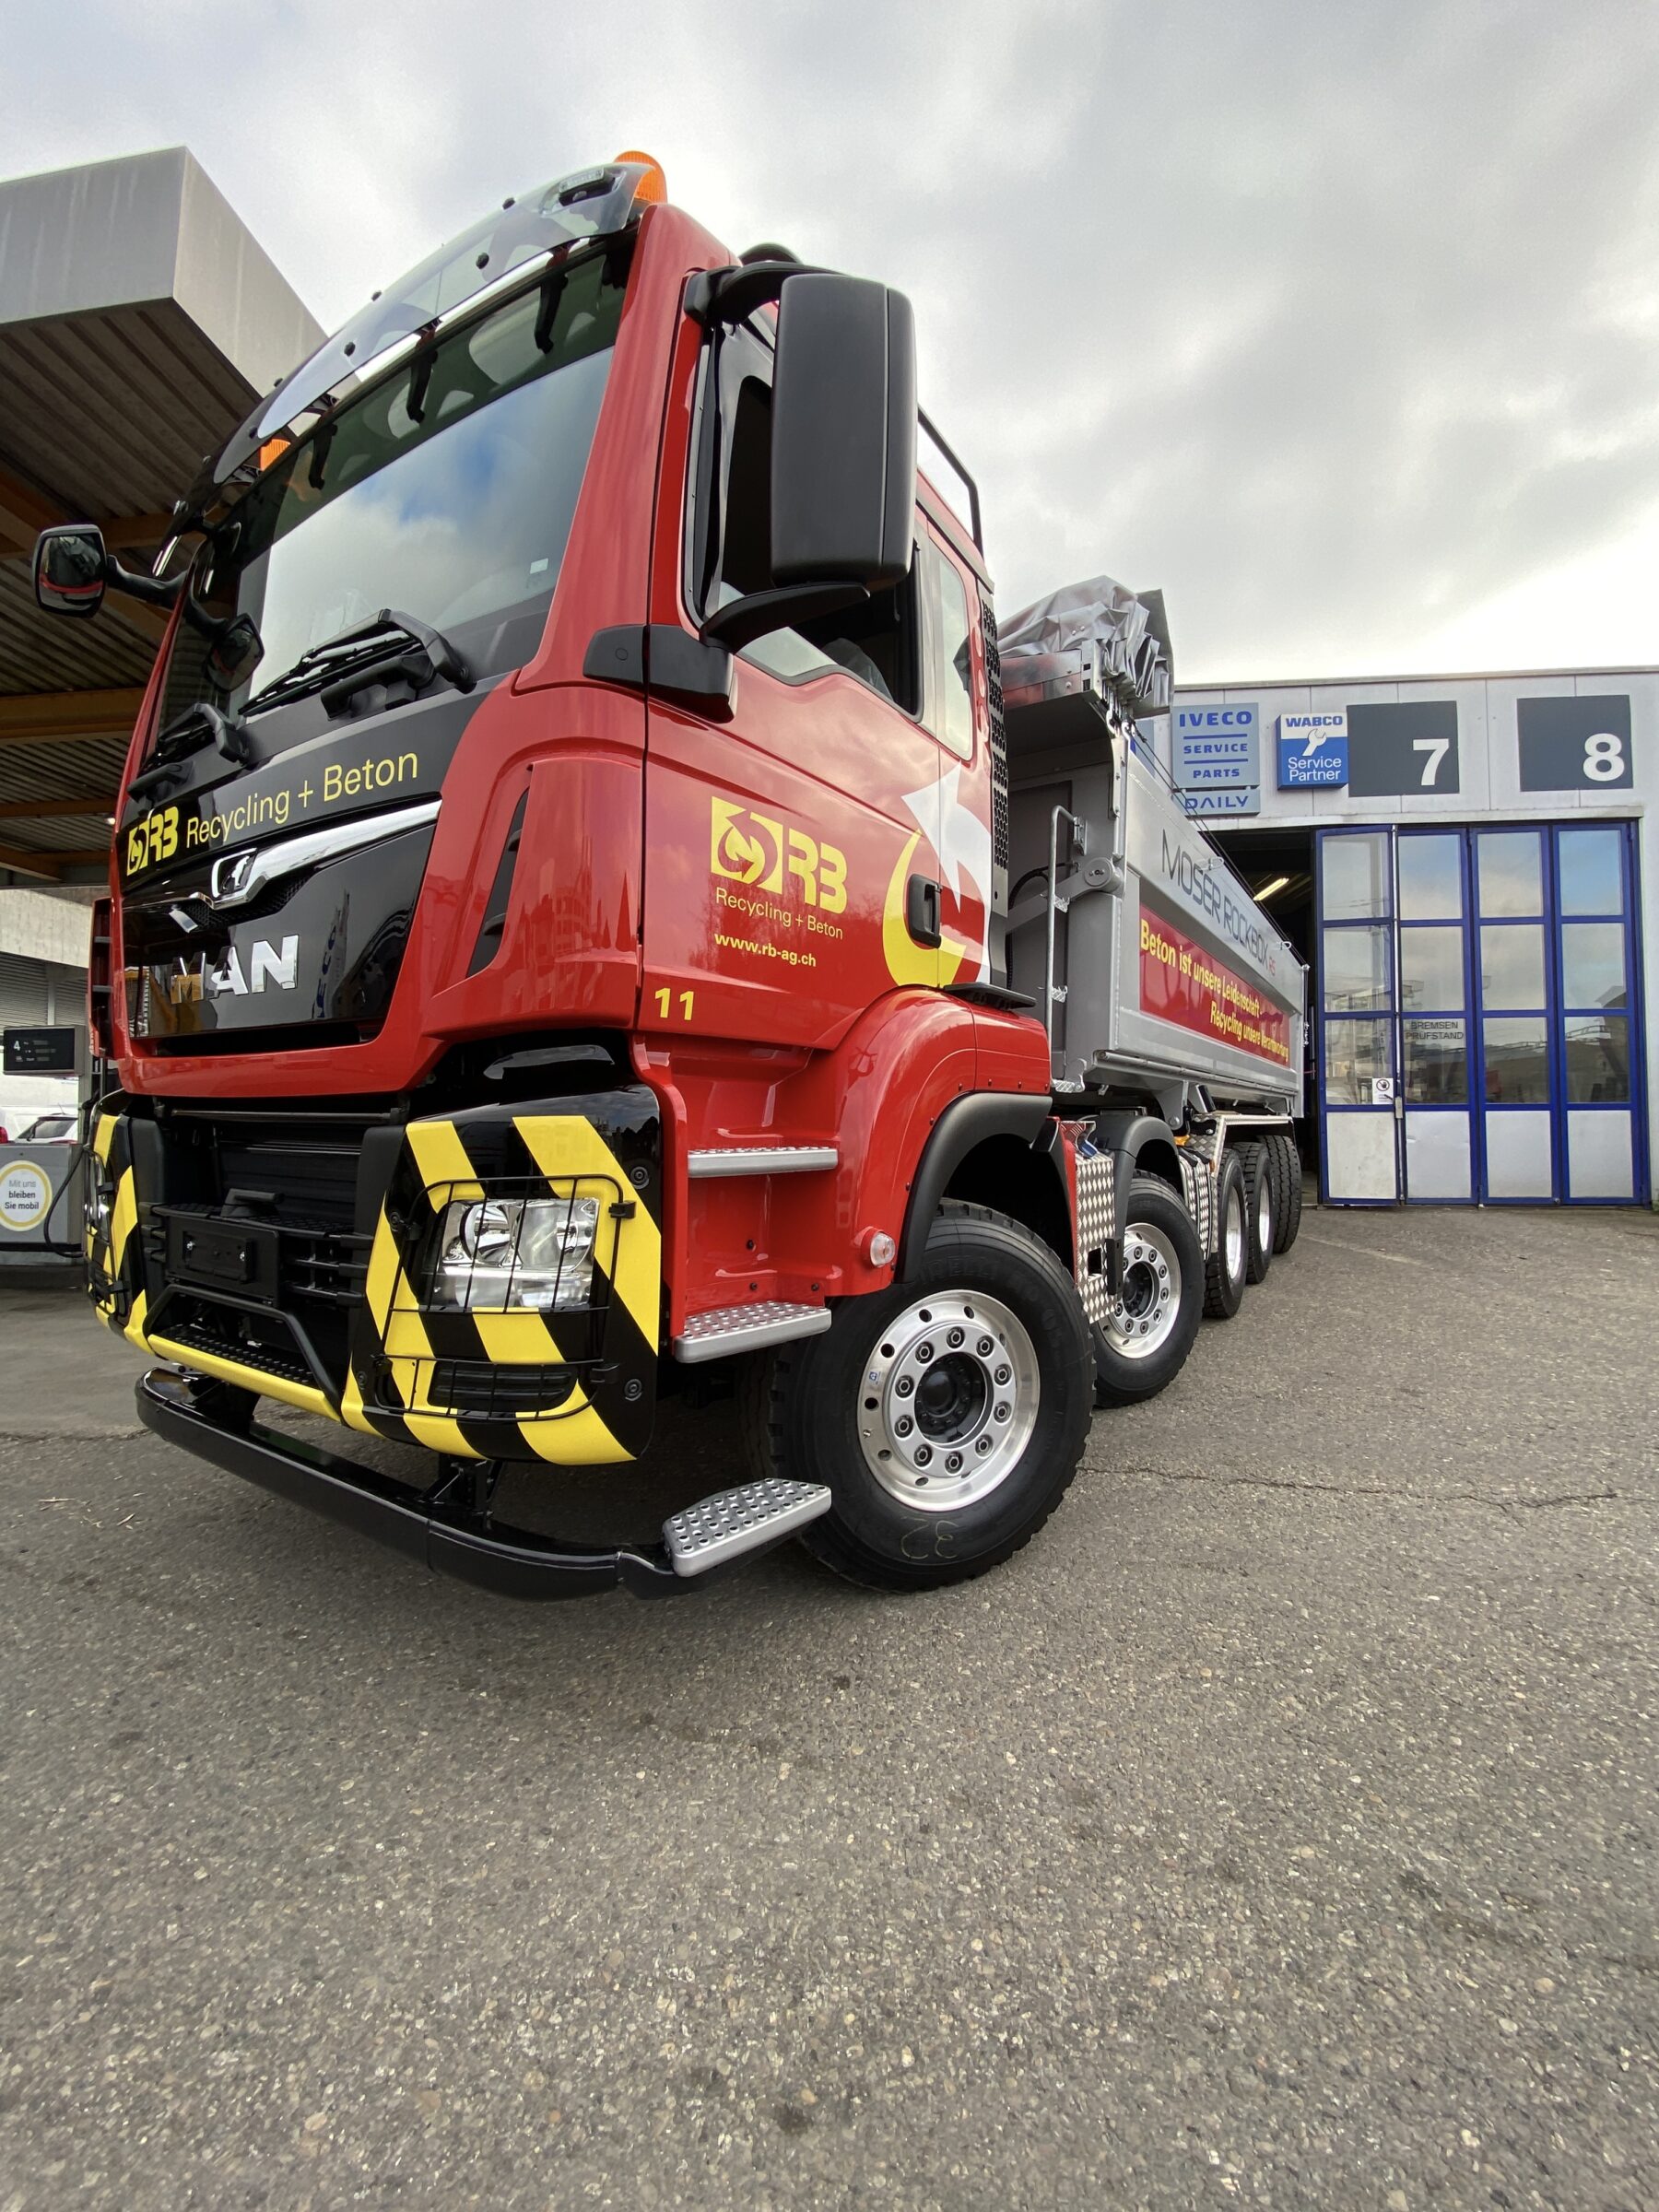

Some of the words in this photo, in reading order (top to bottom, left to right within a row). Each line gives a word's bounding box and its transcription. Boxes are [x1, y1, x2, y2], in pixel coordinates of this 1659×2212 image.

[1179, 711, 1253, 727] IVECO
[1286, 715, 1343, 727] WABCO
[1183, 743, 1248, 754] SERVICE
[1288, 756, 1342, 770] Service
[1413, 738, 1450, 786] 7
[1583, 733, 1625, 782] 8
[1193, 768, 1241, 779] PARTS
[1289, 768, 1341, 782] Partner
[186, 790, 290, 848] Recycling
[298, 780, 314, 807] +
[324, 752, 418, 802] Beton
[1185, 795, 1249, 809] DAILY
[788, 828, 848, 914] RB
[1161, 829, 1221, 924] MOSER
[1223, 895, 1269, 970] ROCKBOX
[715, 887, 792, 928] Recycling
[795, 913, 804, 927] +
[807, 914, 843, 940] Beton
[714, 933, 817, 968] www.rb-ag.ch
[171, 934, 299, 1005] MAN
[1140, 918, 1176, 968] Beton
[1179, 945, 1193, 977] ist
[1194, 962, 1222, 994] unsere
[1222, 975, 1260, 1018] Leidenschaft
[654, 987, 694, 1021] 11
[1210, 1000, 1243, 1041] Recycling
[1410, 1021, 1458, 1030] BREMSEN
[13, 1041, 20, 1051] 4
[8, 1180, 20, 1188] Mit
[8, 1191, 36, 1199] bleiben
[5, 1201, 17, 1209] Sie
[18, 1201, 40, 1210] mobil
